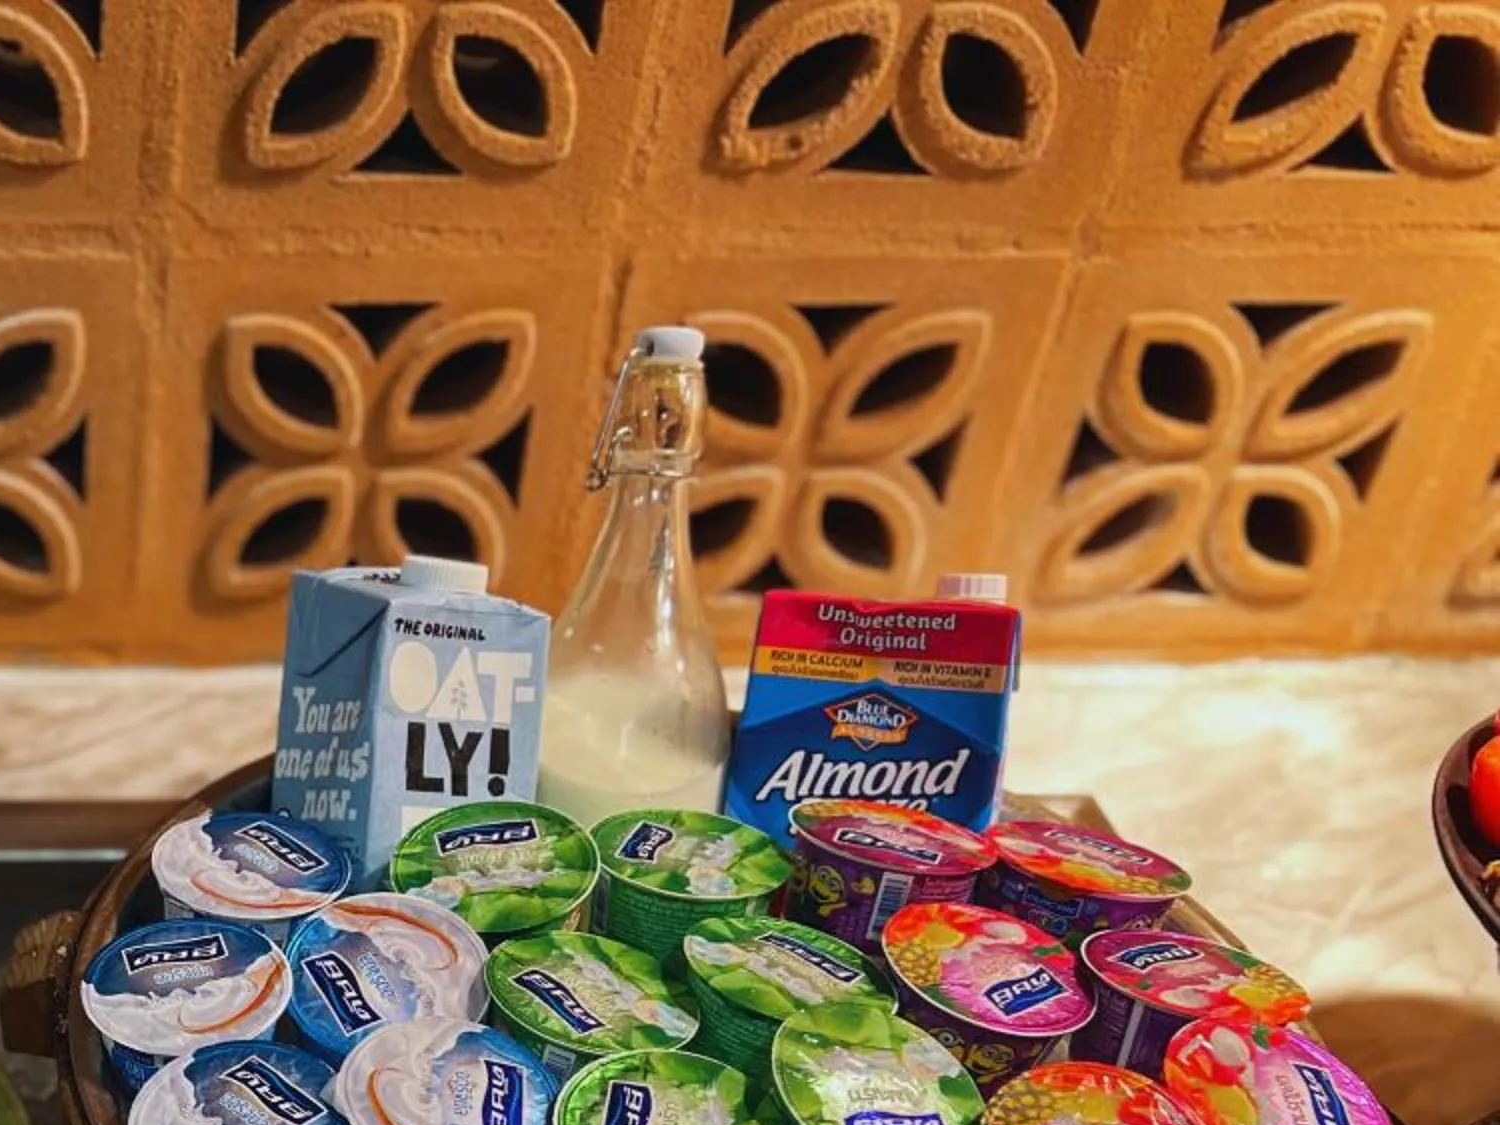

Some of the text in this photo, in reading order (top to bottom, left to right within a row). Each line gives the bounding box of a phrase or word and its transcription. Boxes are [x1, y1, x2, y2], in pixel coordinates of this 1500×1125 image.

[394, 618, 487, 641] THE ORIGINAL
[818, 603, 956, 631] Unsweetened
[839, 628, 927, 652] Original
[809, 654, 864, 669] CALCIUM
[389, 641, 536, 726] OAT-
[292, 686, 362, 735] You are
[275, 749, 313, 781] one
[313, 738, 338, 778] of
[404, 721, 511, 798] LY!
[755, 748, 971, 801] Almond
[300, 787, 357, 822] now.
